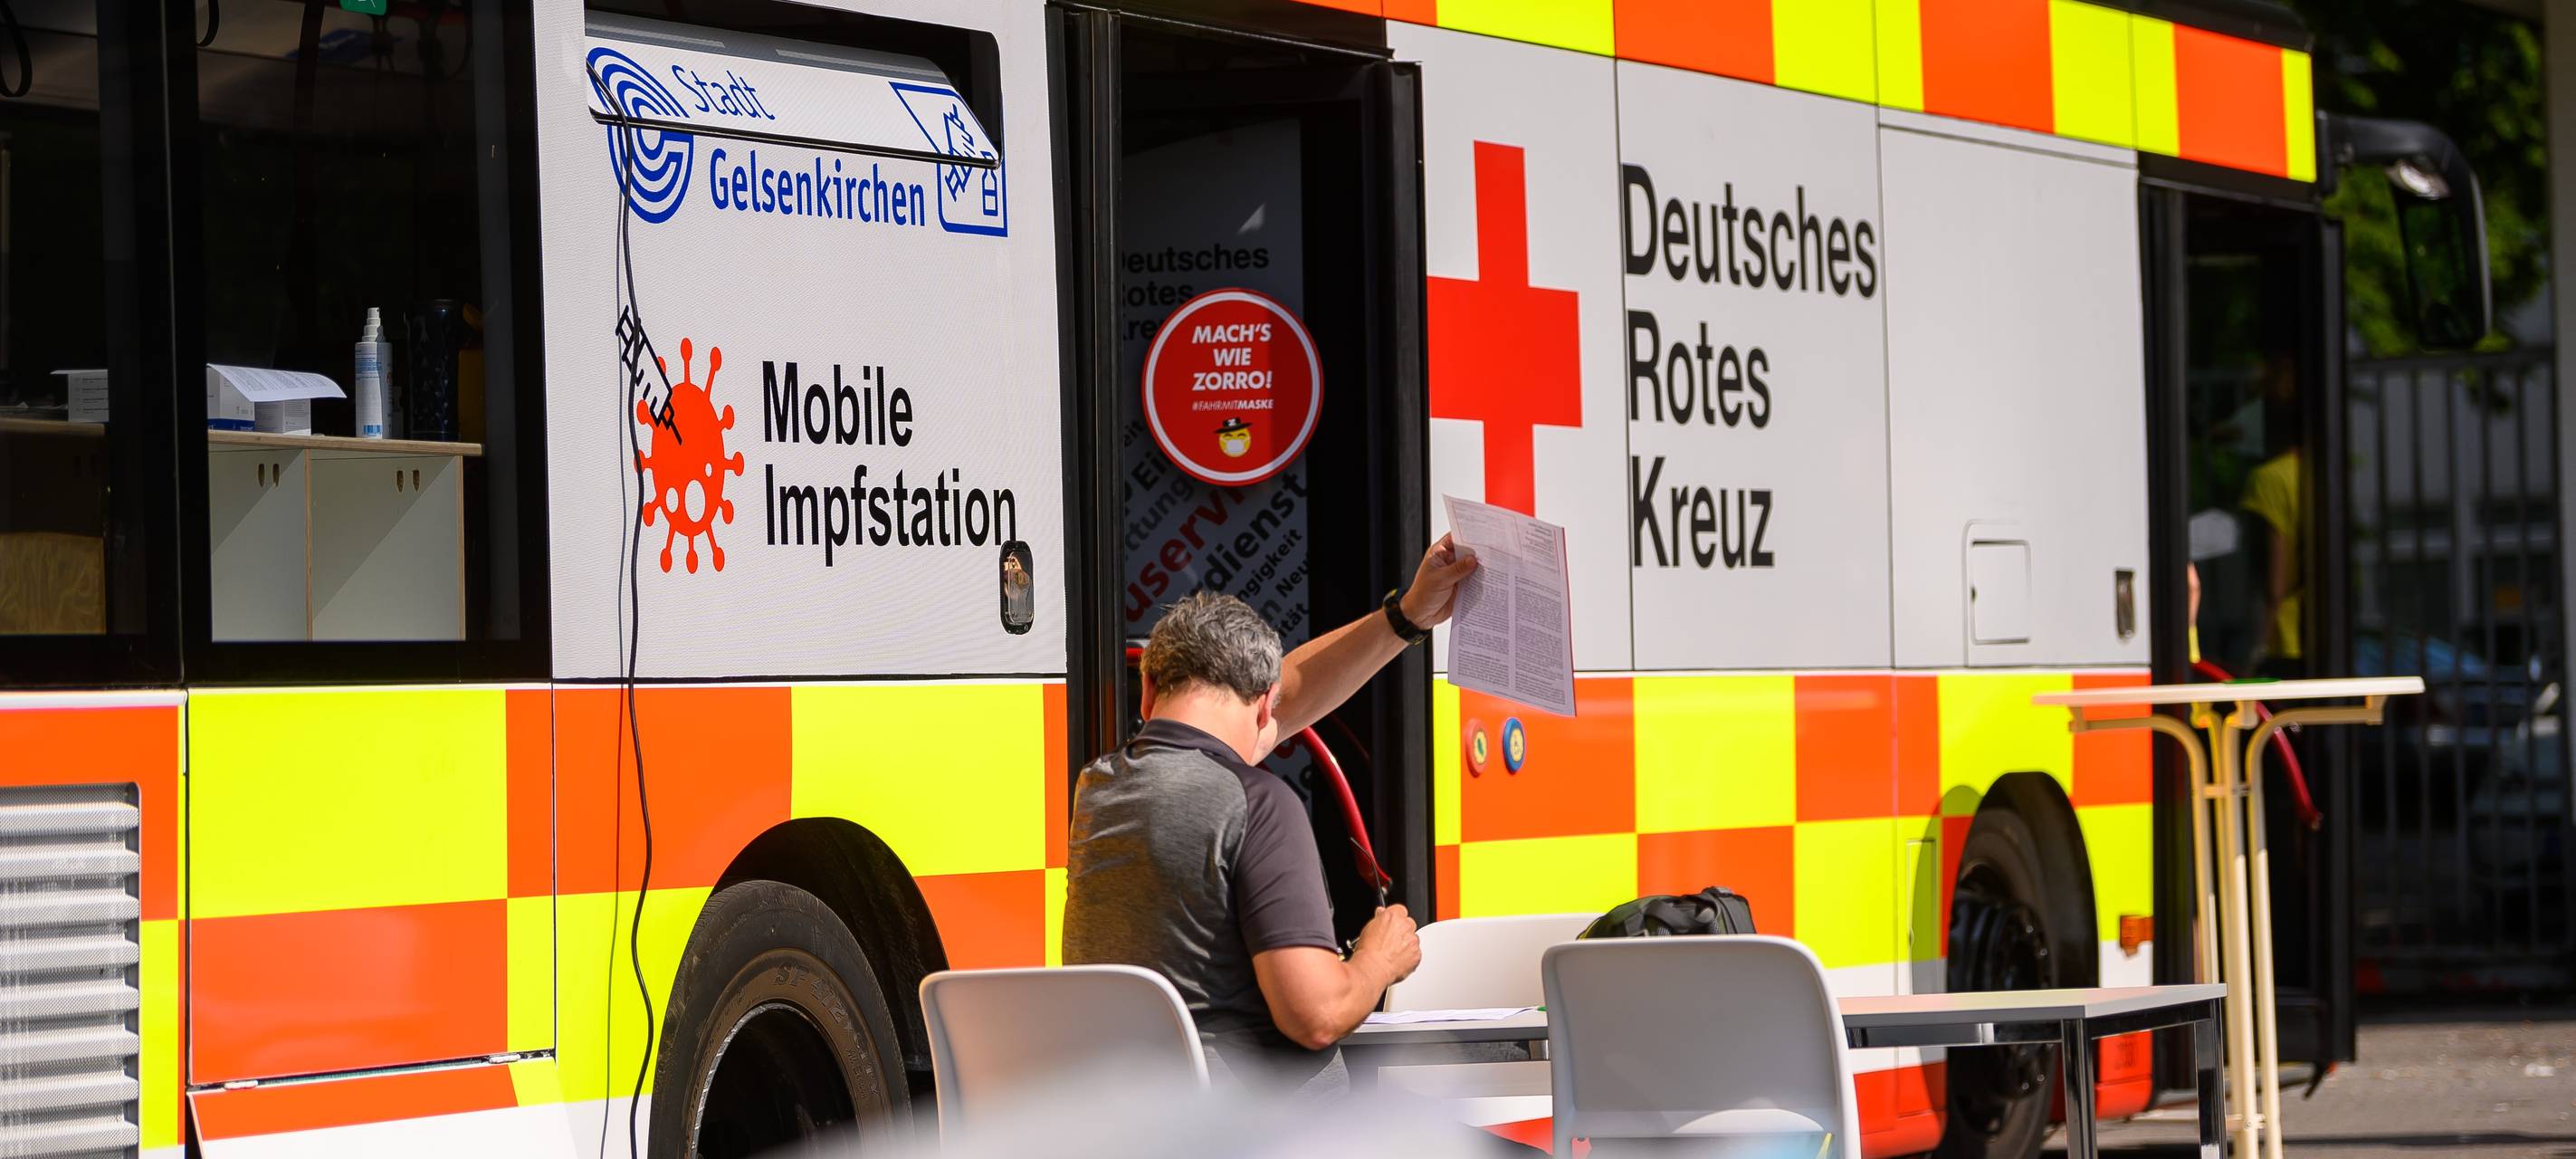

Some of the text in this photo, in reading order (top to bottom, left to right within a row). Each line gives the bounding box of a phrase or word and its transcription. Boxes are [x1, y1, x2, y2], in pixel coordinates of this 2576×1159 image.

[672, 63, 776, 121] Stadt
[710, 148, 926, 226] Gelsenkirchen
[1622, 163, 1877, 299] Deutsches
[1122, 283, 1194, 307] otes
[1192, 323, 1273, 345] MACH'S
[1192, 370, 1274, 392] ZORRO!
[1213, 348, 1252, 367] WIE
[1627, 309, 1772, 429] Rotes
[762, 360, 914, 447] Mobile
[765, 463, 1017, 568] Impfstation
[1630, 455, 1775, 569] Kreuz
